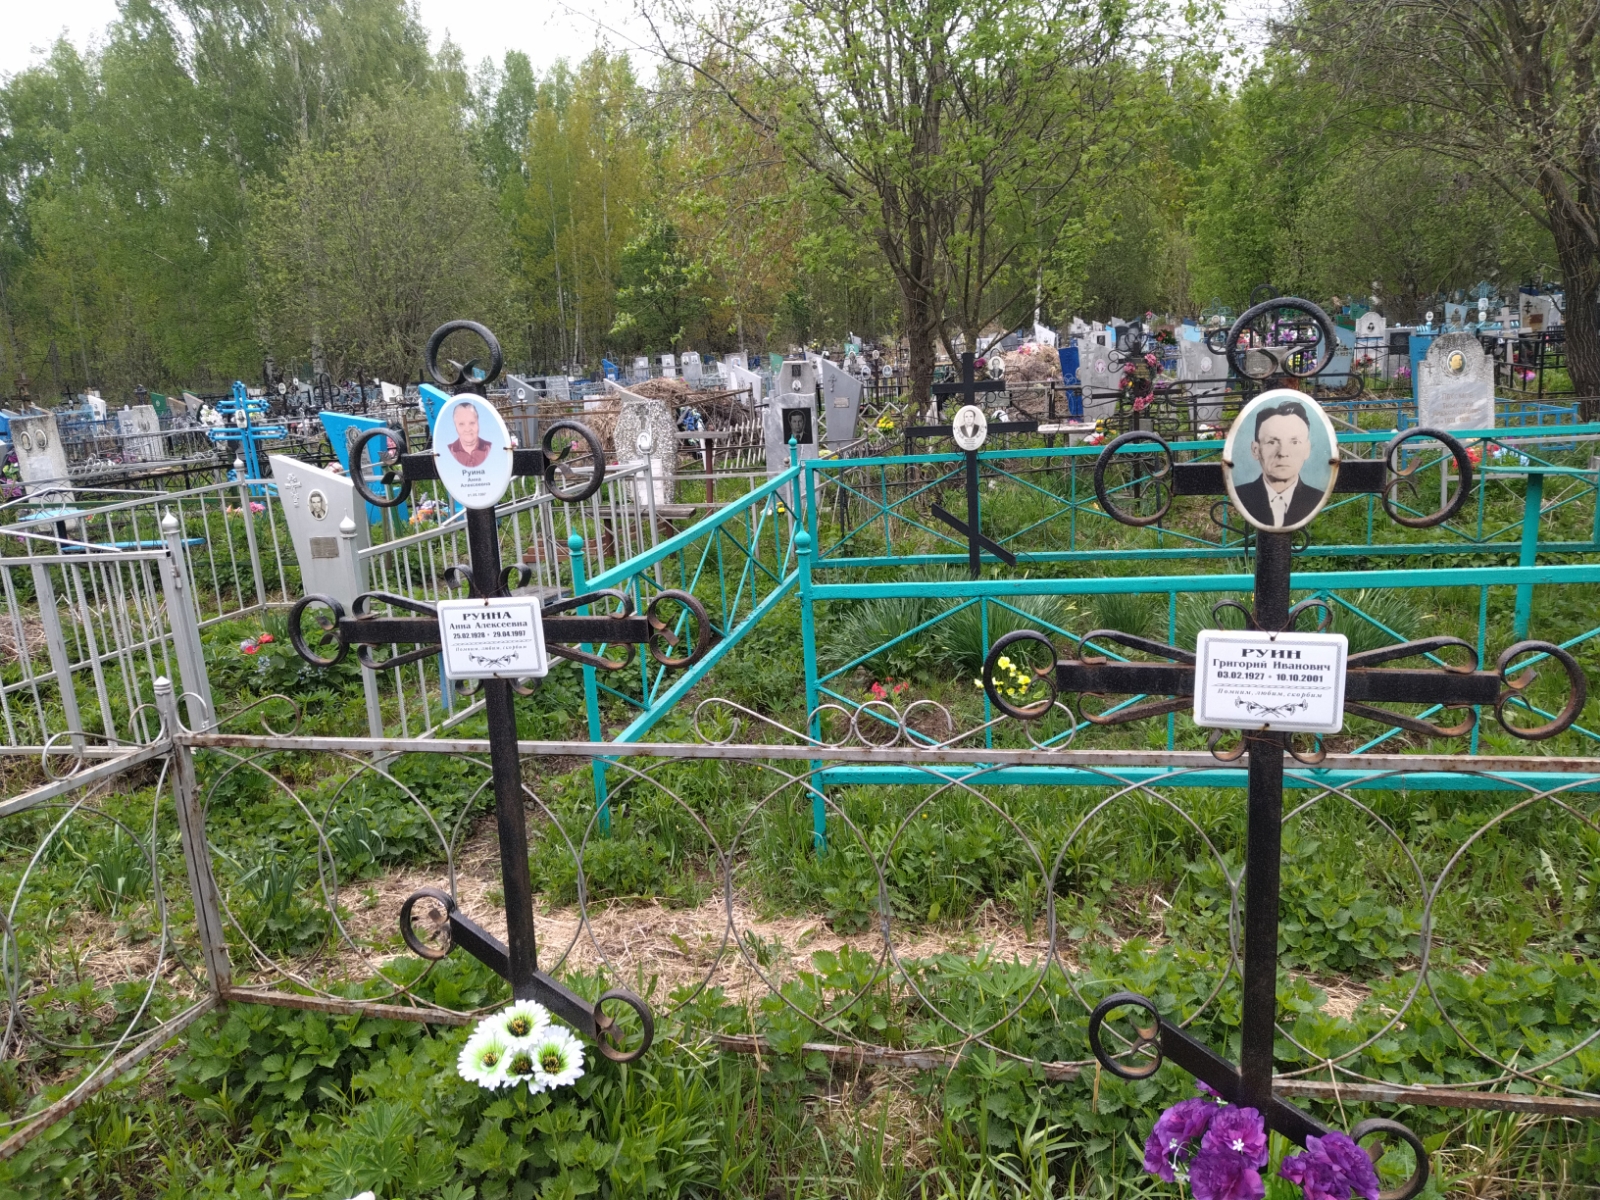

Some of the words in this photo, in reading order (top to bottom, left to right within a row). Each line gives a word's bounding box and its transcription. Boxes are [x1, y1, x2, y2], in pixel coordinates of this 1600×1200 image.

[462, 611, 512, 621] РУИНА
[475, 620, 528, 629] Алексеевна
[492, 630, 526, 638] 29.04.1997
[1241, 648, 1302, 660] РУИН
[1213, 658, 1268, 670] Григорий
[1273, 660, 1331, 671] Иванович
[1217, 670, 1265, 680] 03.02.1927
[1276, 673, 1324, 683] 10.10.2001
[1287, 691, 1323, 699] скорбим
